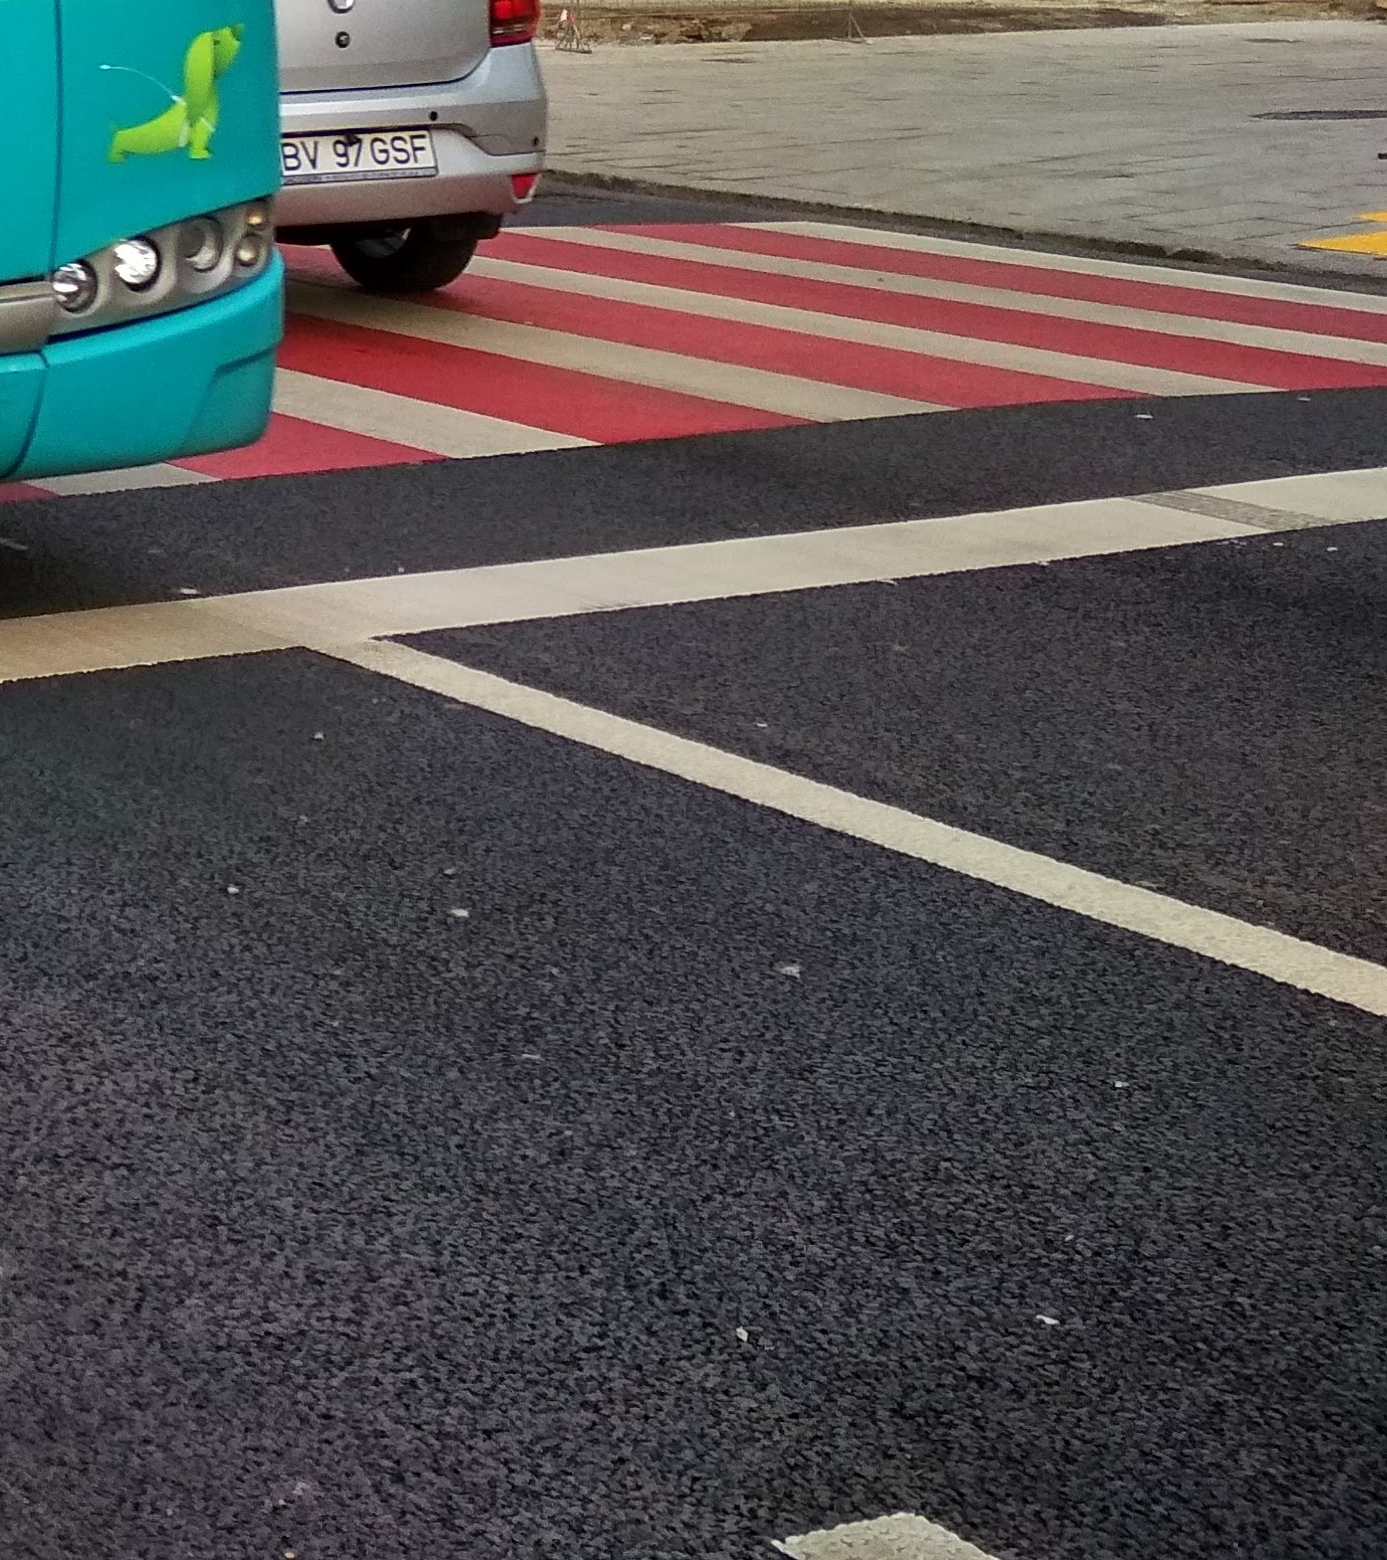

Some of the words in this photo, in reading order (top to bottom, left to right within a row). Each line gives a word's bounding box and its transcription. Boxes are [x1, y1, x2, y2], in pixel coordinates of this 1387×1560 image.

[281, 141, 320, 171] BV
[333, 137, 363, 169] 97
[370, 133, 427, 166] GSF
